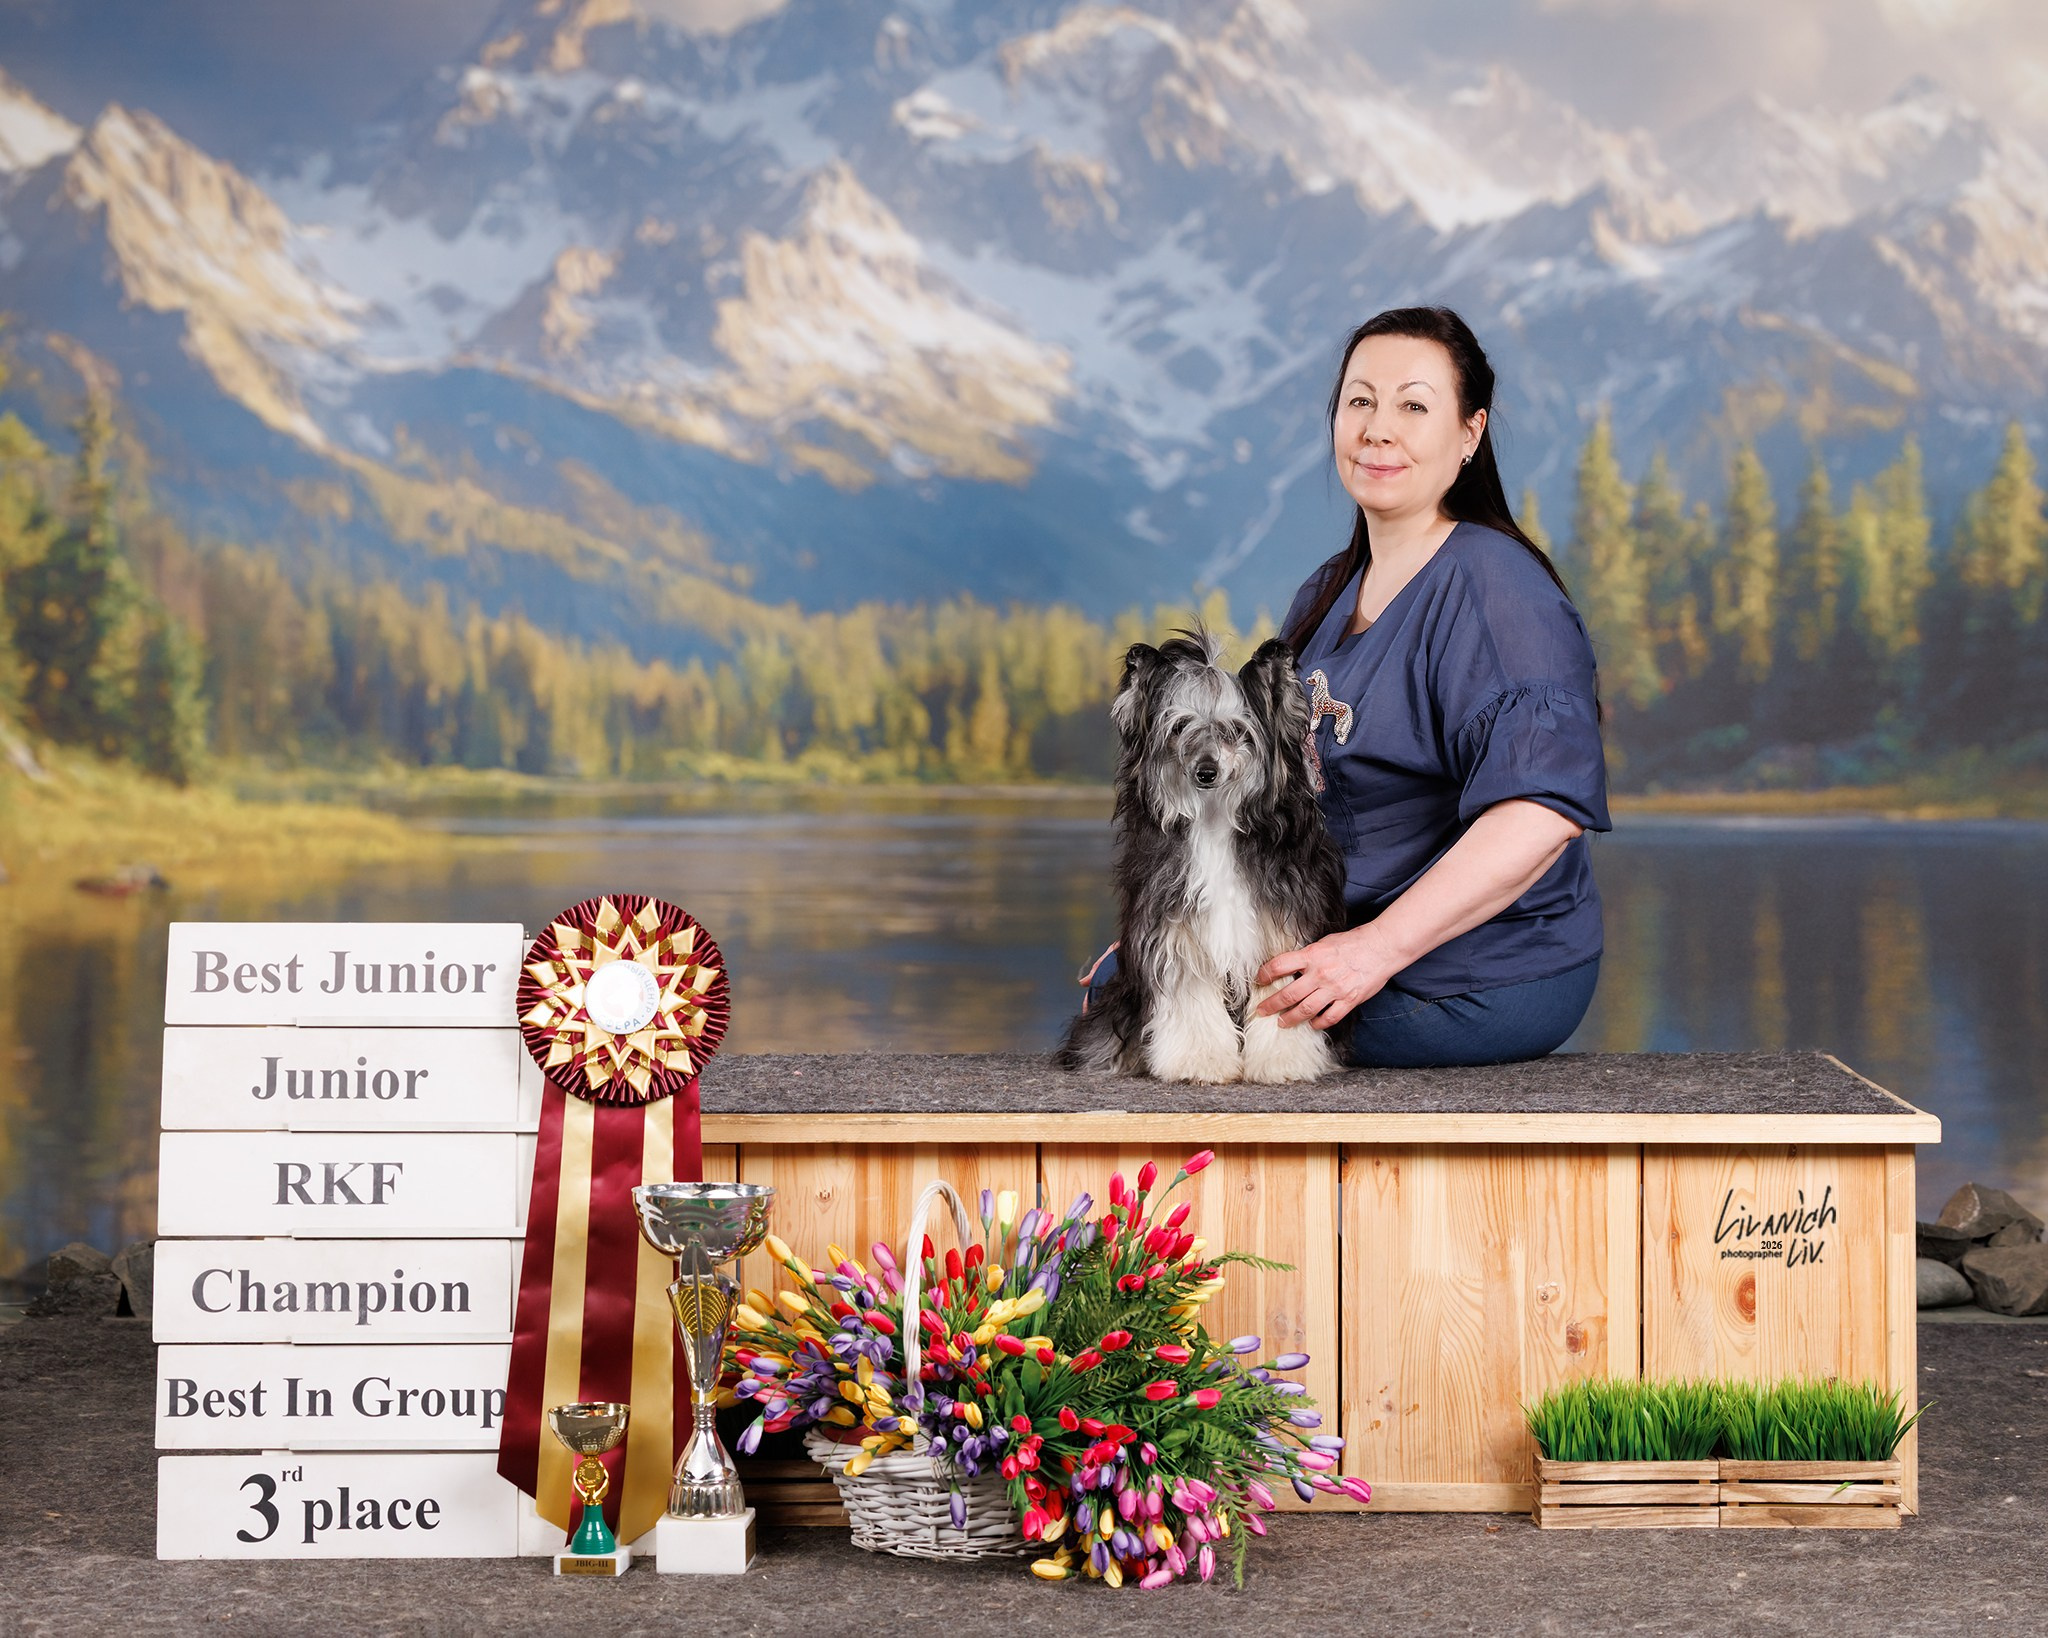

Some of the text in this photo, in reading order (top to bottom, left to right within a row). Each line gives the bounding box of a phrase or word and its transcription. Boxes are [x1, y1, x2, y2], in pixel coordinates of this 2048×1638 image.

[191, 951, 496, 994] Best Junior
[251, 1056, 429, 1100] Junior
[273, 1162, 404, 1205] RKF
[191, 1268, 471, 1326] Champion
[163, 1376, 506, 1429] Best In Group
[301, 1486, 441, 1544] place
[575, 1560, 609, 1568] JBIG-III
